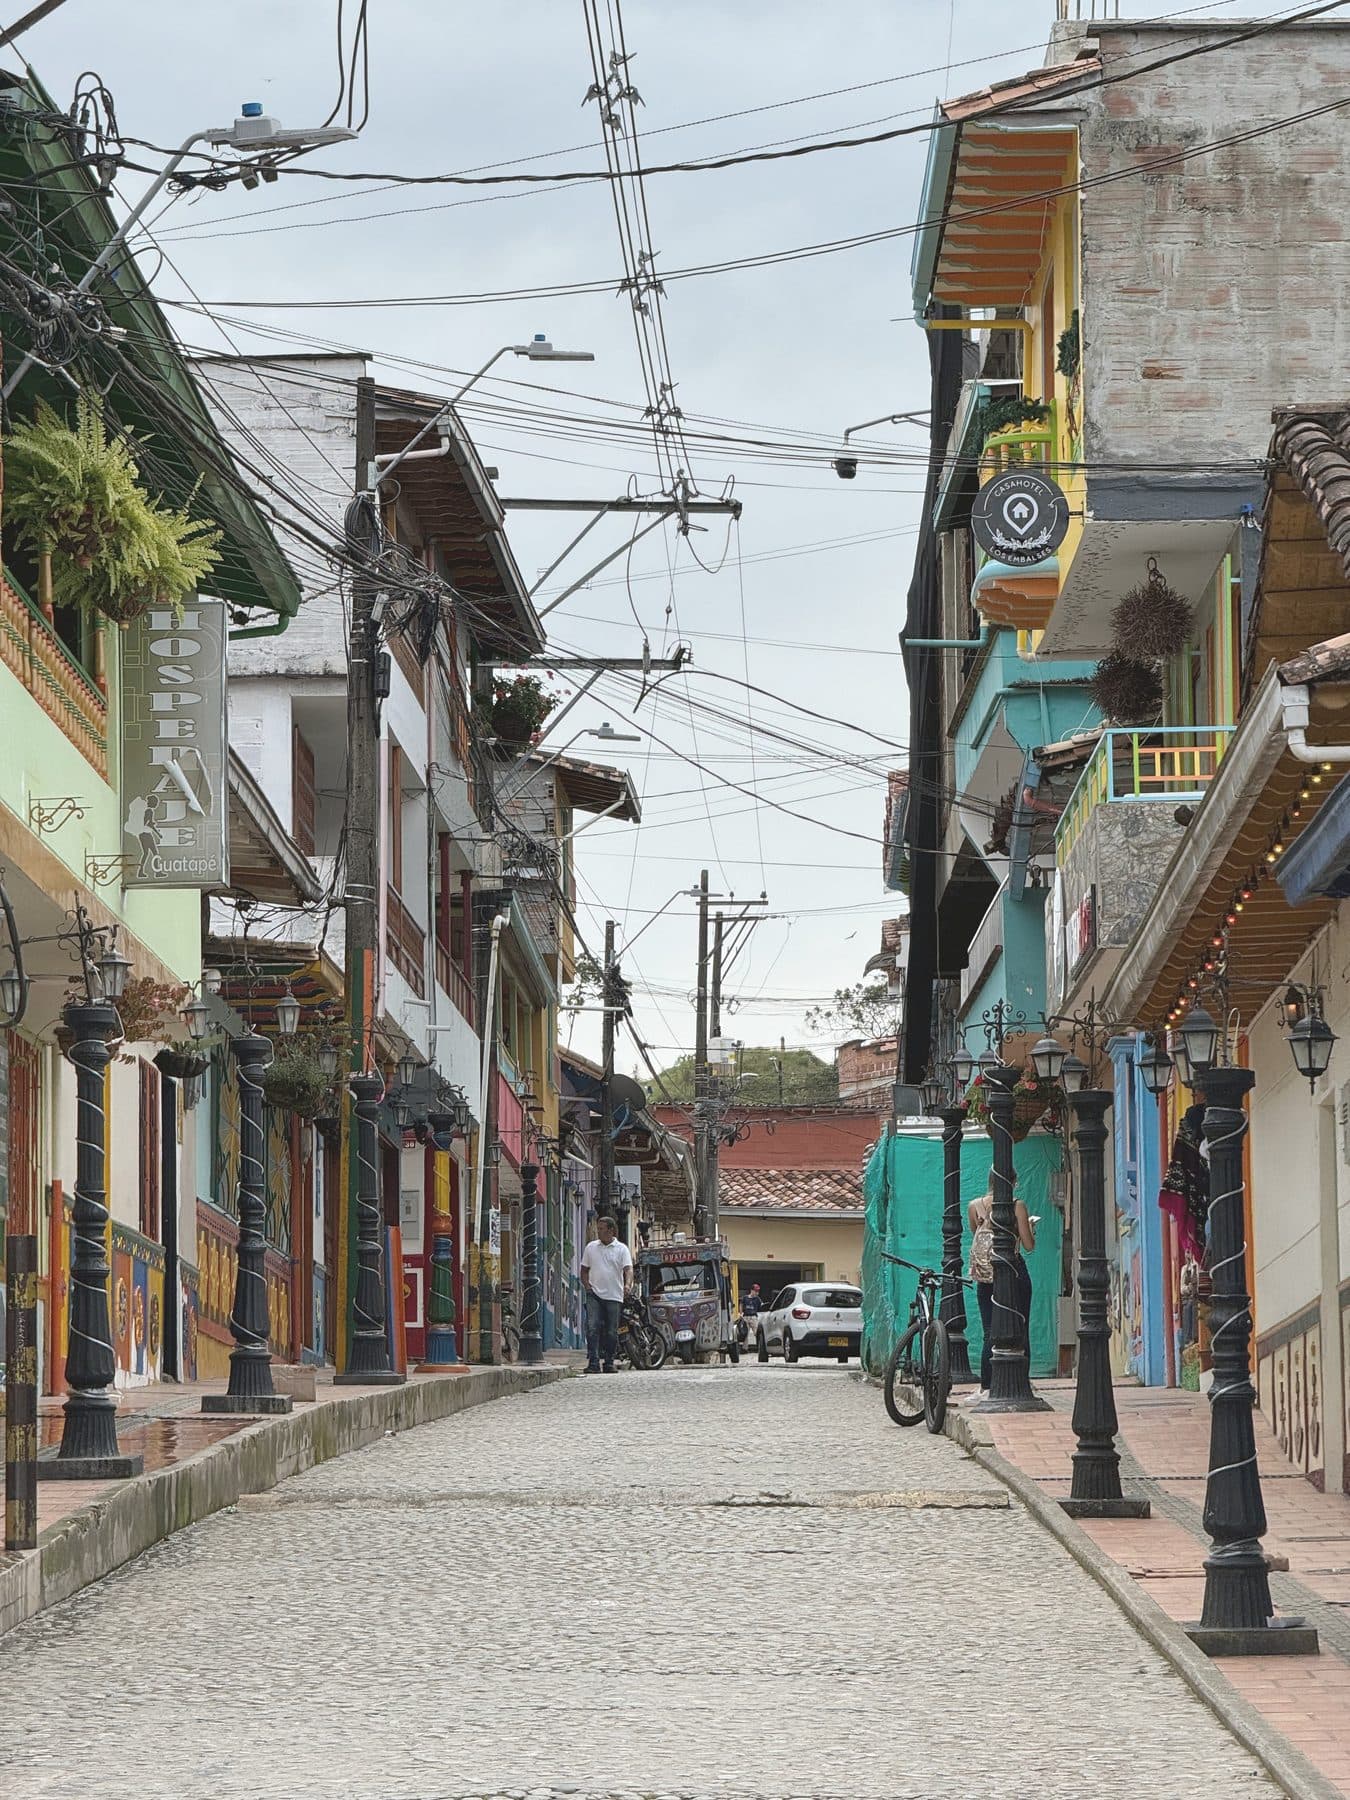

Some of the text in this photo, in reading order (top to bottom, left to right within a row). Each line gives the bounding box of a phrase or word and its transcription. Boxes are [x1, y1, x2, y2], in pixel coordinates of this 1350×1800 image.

[994, 480, 1044, 497] CASAHOTEL
[989, 546, 1052, 563] LOS EMBALSES
[151, 855, 218, 873] Guatapé
